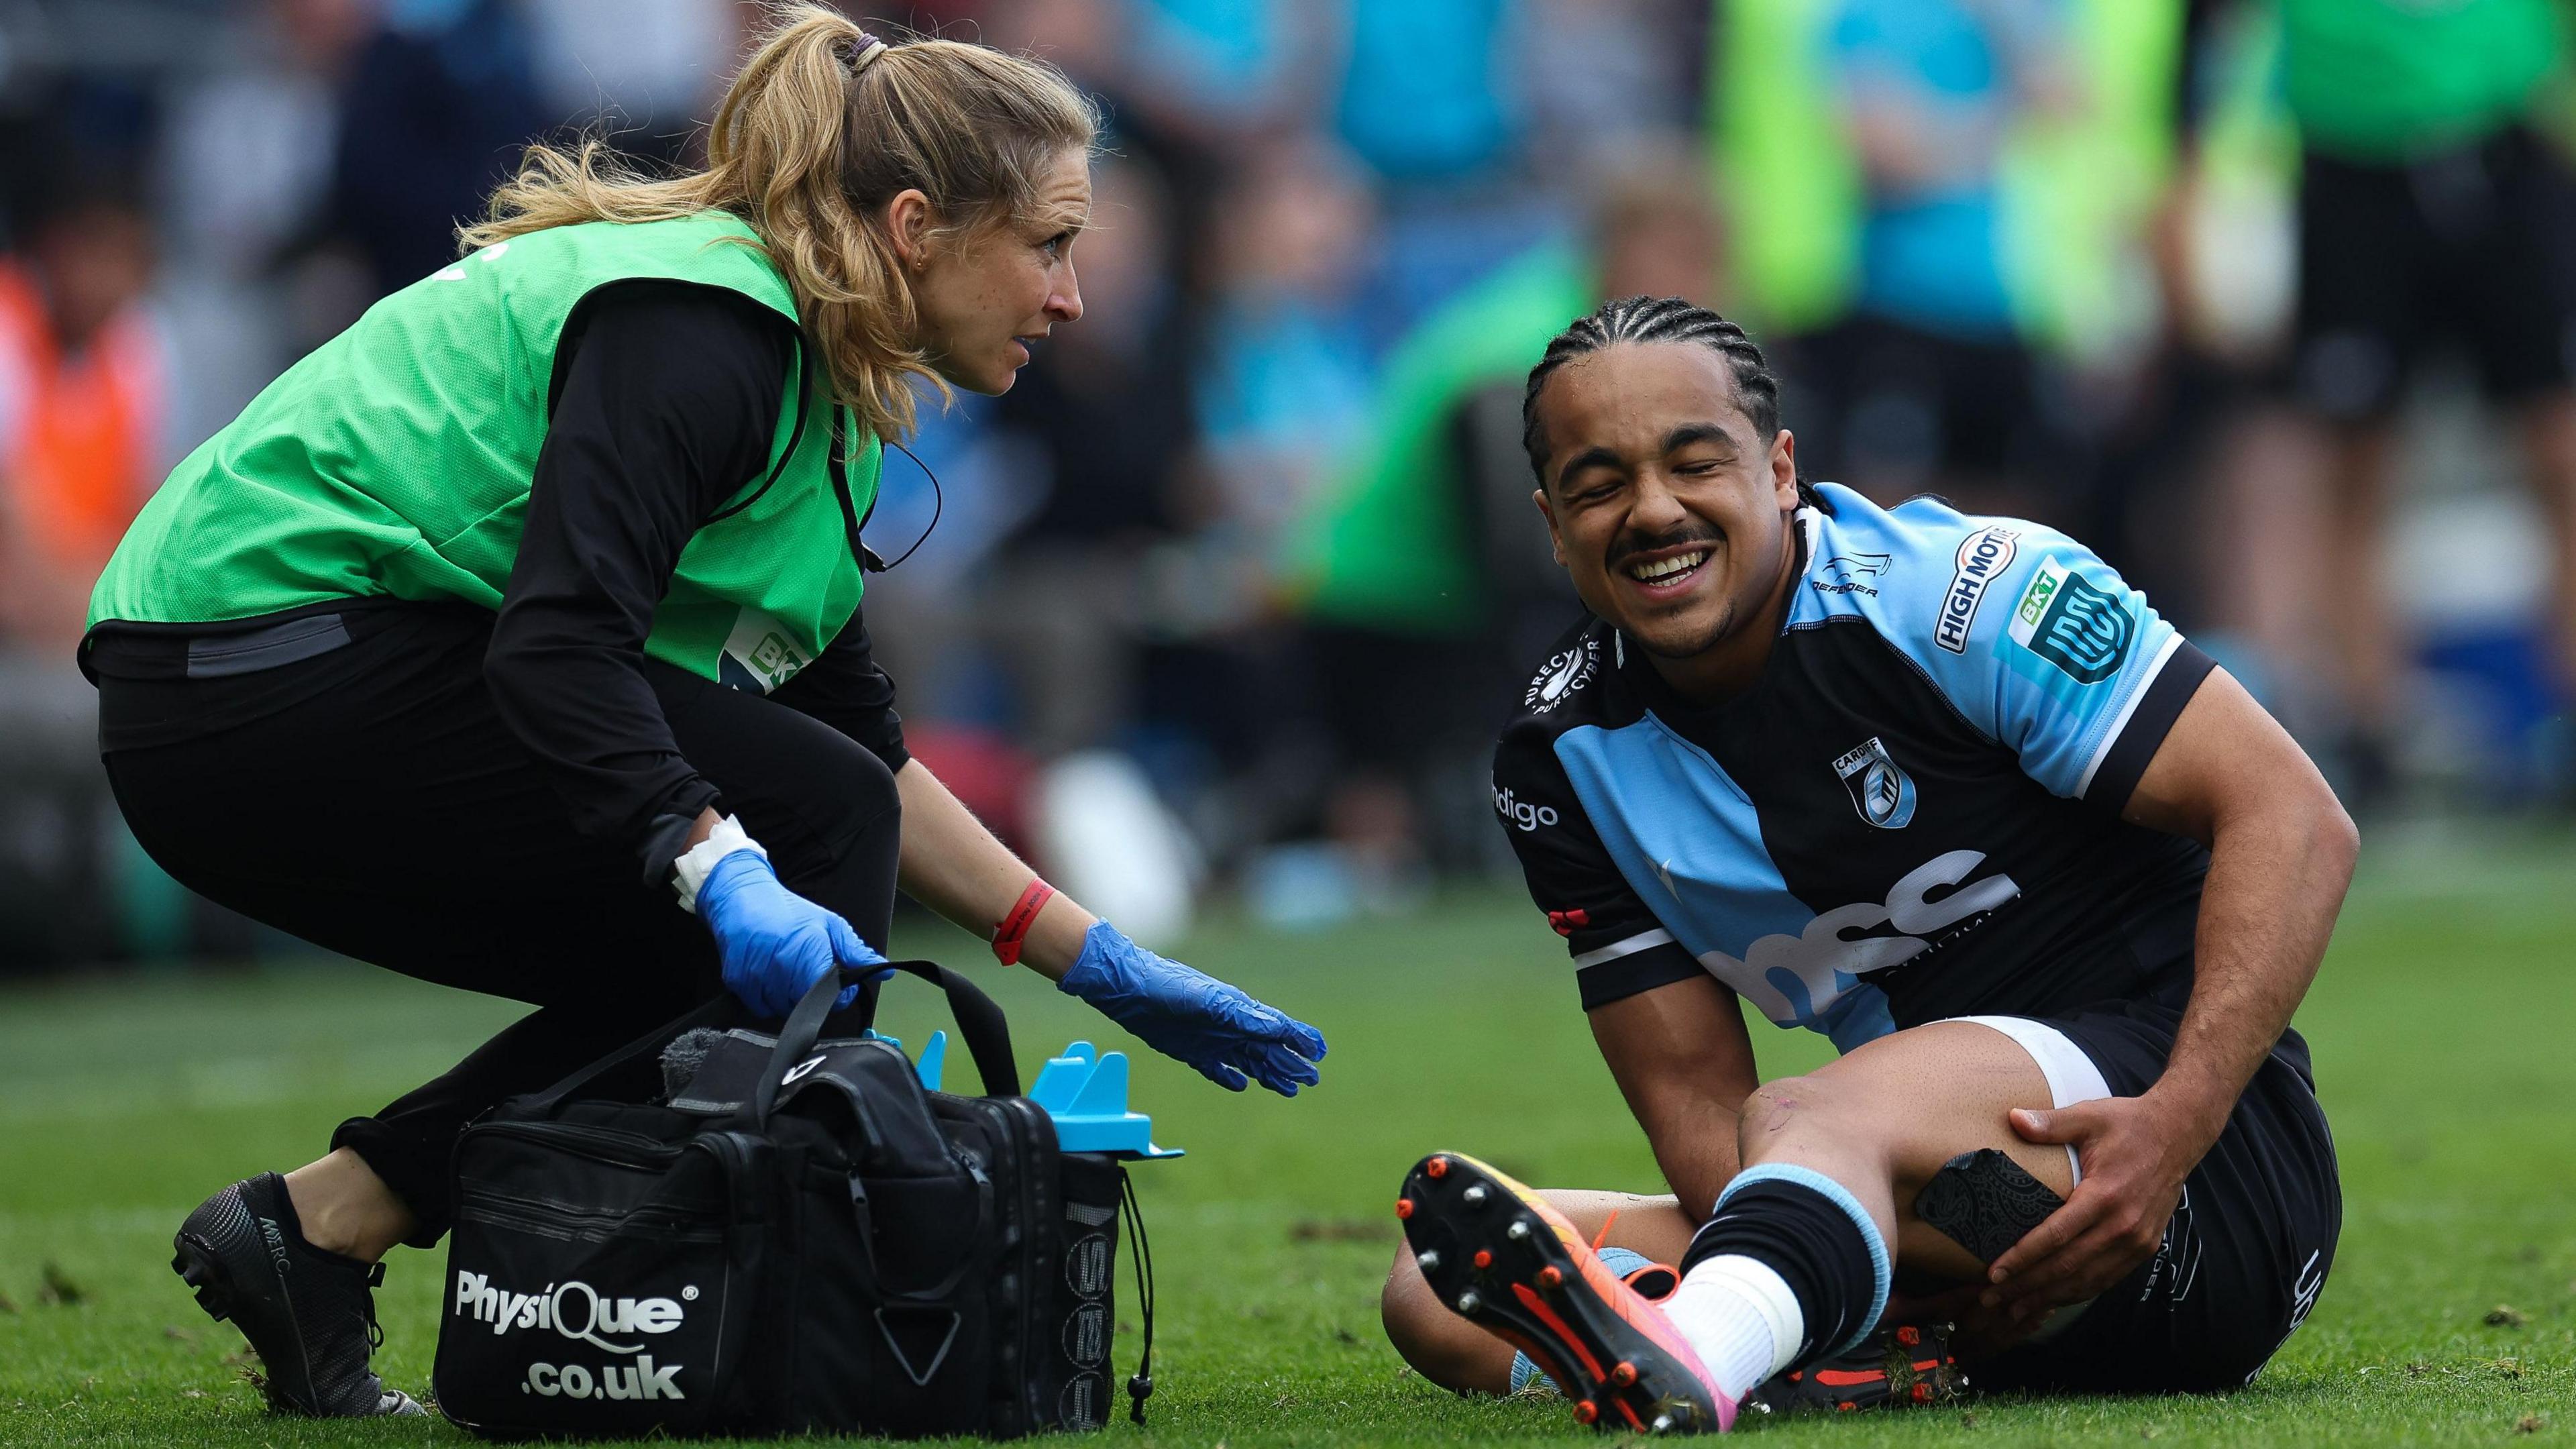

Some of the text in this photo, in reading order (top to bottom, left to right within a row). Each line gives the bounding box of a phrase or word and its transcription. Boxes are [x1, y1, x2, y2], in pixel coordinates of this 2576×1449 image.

[1941, 574, 1980, 646] HIGH
[2020, 570, 2058, 626] BKT
[1835, 739, 1878, 770] CARDIFF
[521, 1354, 685, 1400] .co.uk
